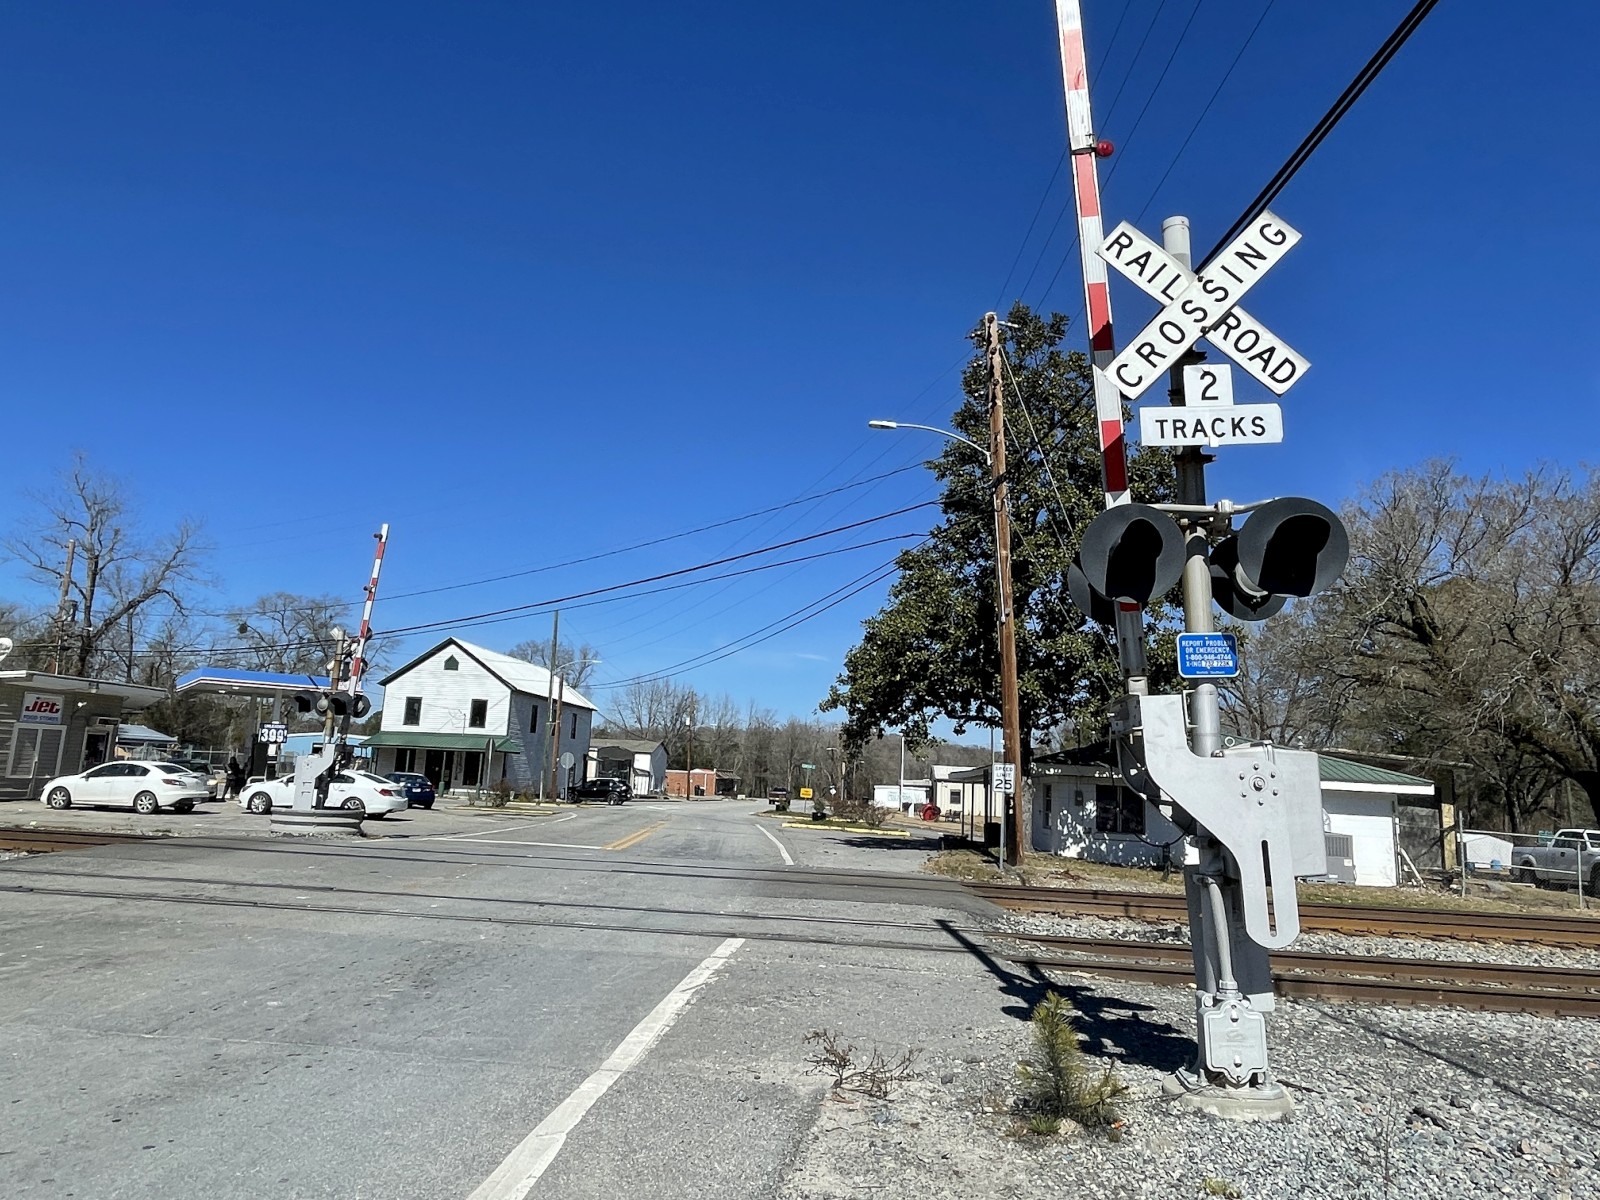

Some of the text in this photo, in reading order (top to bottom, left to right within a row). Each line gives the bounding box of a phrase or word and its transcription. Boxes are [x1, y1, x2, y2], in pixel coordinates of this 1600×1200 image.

[1116, 223, 1287, 388] CROSSING
[1199, 371, 1219, 401] 2
[1155, 416, 1266, 439] TRACKS
[995, 779, 1012, 790] 25
